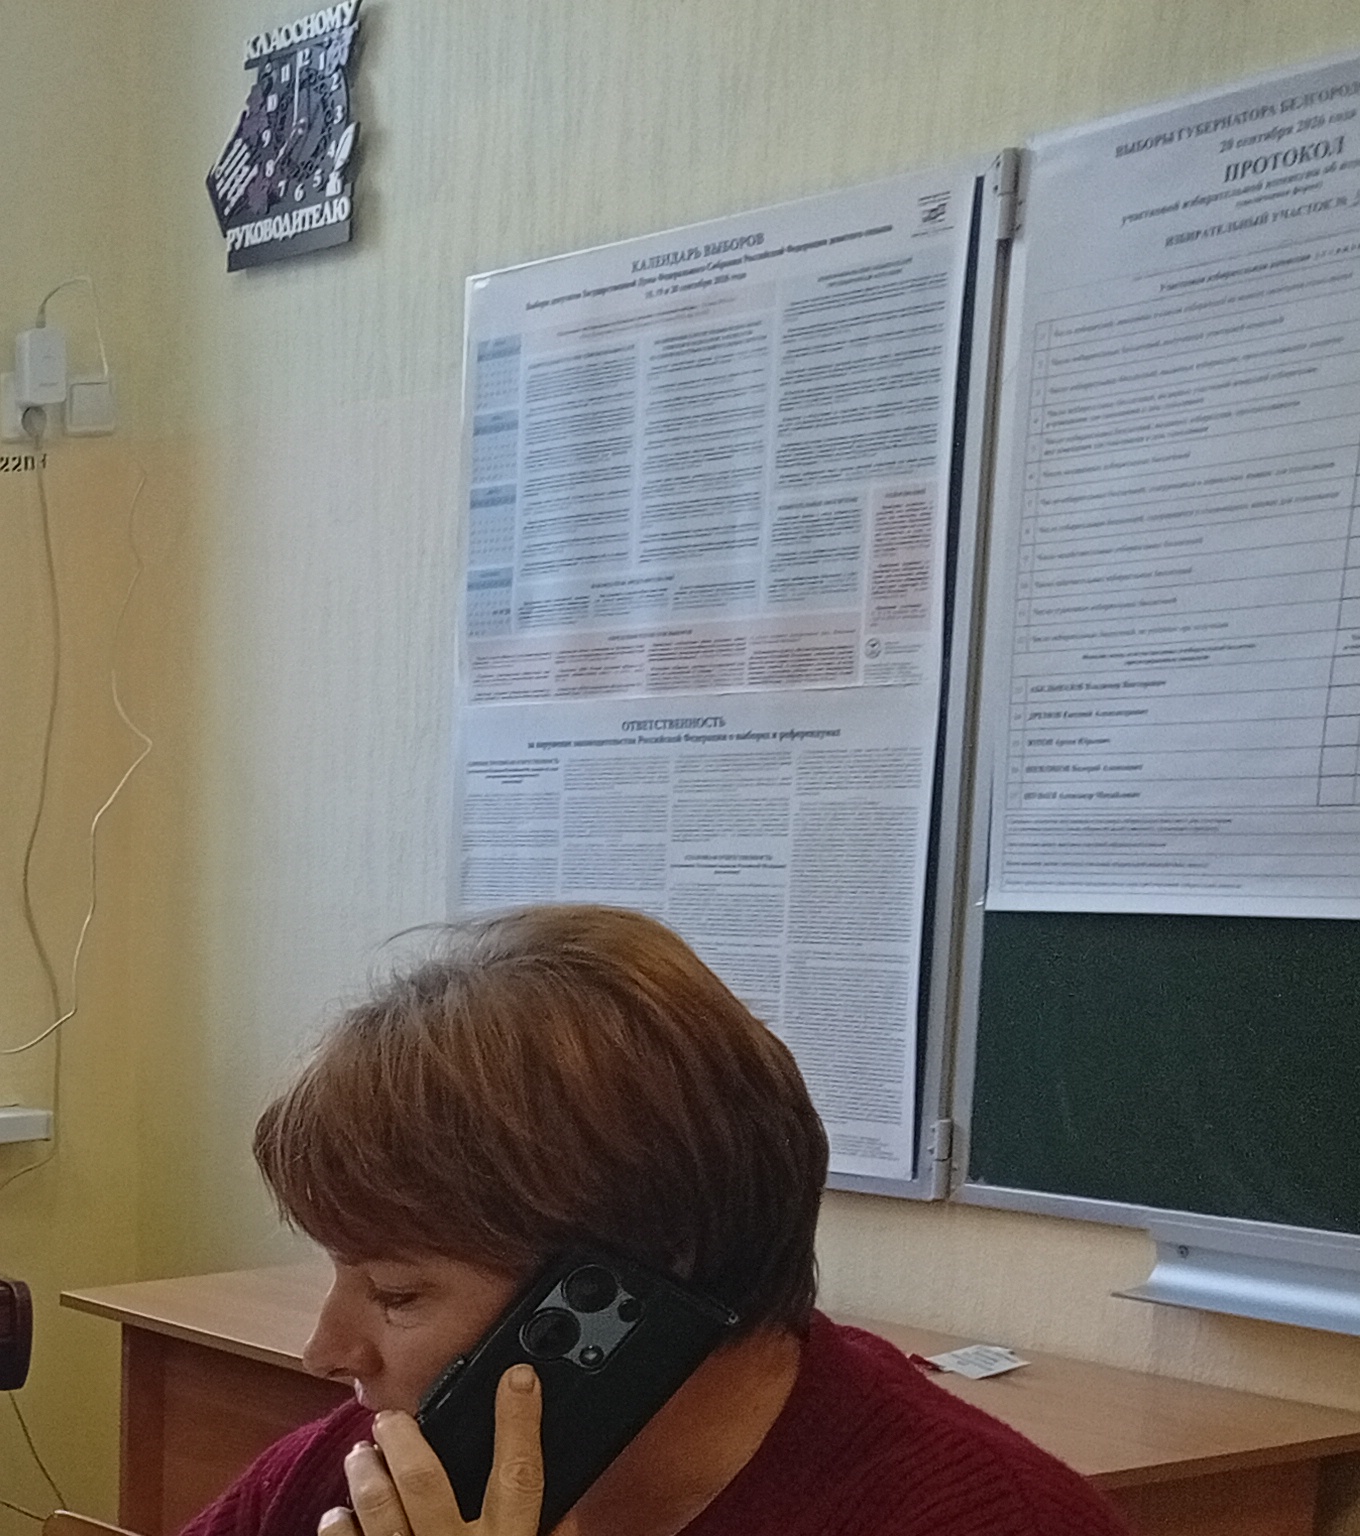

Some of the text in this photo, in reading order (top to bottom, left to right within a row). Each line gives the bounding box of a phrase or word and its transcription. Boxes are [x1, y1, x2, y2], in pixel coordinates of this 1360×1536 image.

[1115, 130, 1174, 158] ВЫБОРЫ
[1177, 106, 1276, 140] ГУБЕРНАТОРА
[1224, 135, 1346, 184] ПРОТОКОЛ
[226, 196, 351, 252] РУКОВОДИТЕЛЮ
[631, 232, 765, 273] КАЛЕНДАРЬ ВЫБОРОВ
[621, 715, 726, 732] ОТВЕТСТВЕННОСТЬ
